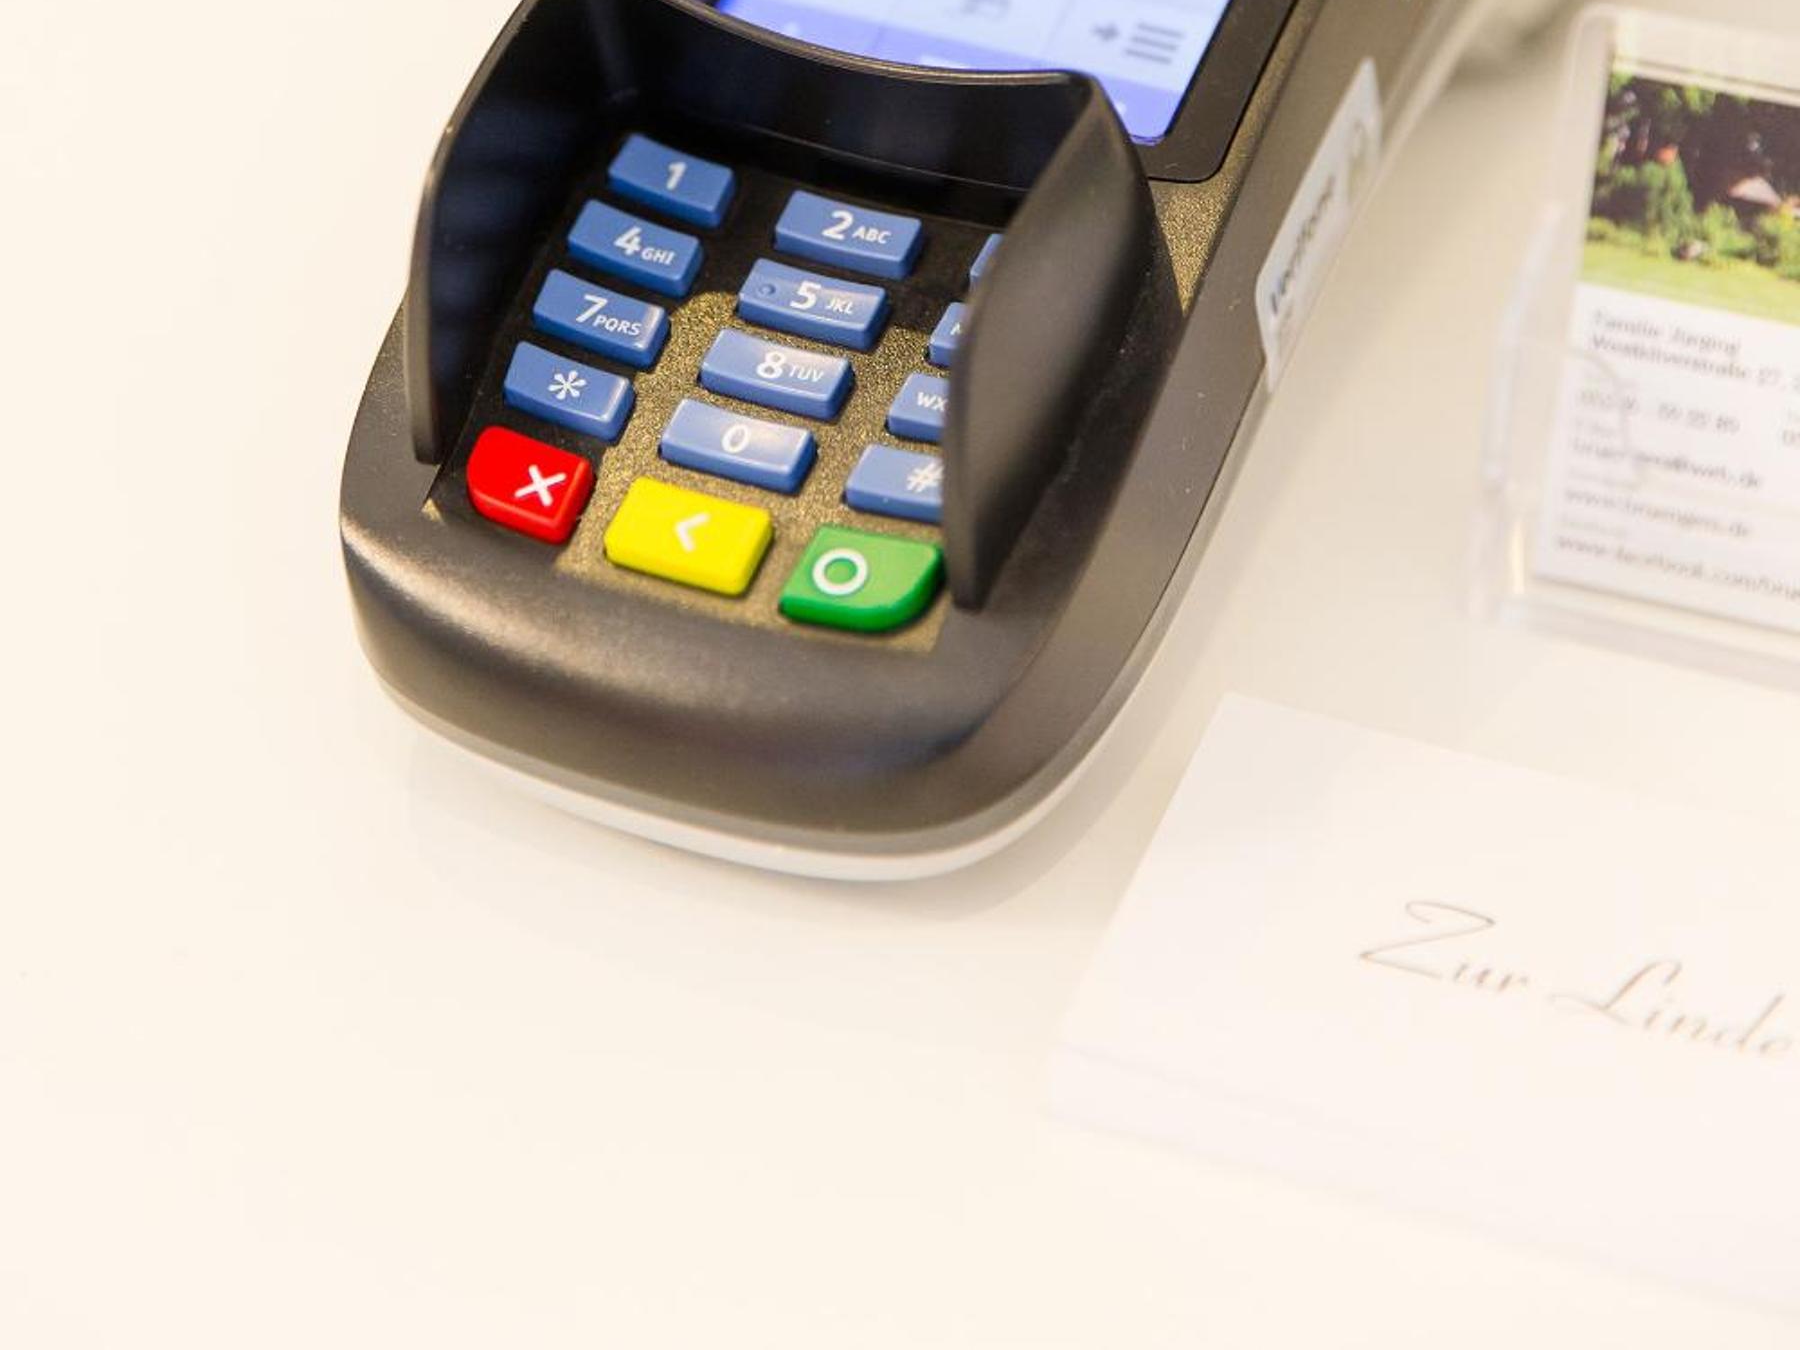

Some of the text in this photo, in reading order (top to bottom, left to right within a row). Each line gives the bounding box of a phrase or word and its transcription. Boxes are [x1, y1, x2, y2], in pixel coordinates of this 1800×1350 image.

[667, 161, 687, 191] 1
[822, 211, 894, 245] 2 ABC
[613, 226, 676, 266] 4 GHI
[790, 280, 854, 315] 5 JKL
[576, 295, 642, 337] 7 PQRS
[756, 351, 825, 383] 8 TUV
[916, 391, 947, 412] WX
[722, 423, 749, 453] 0
[1359, 900, 1529, 992] Zur
